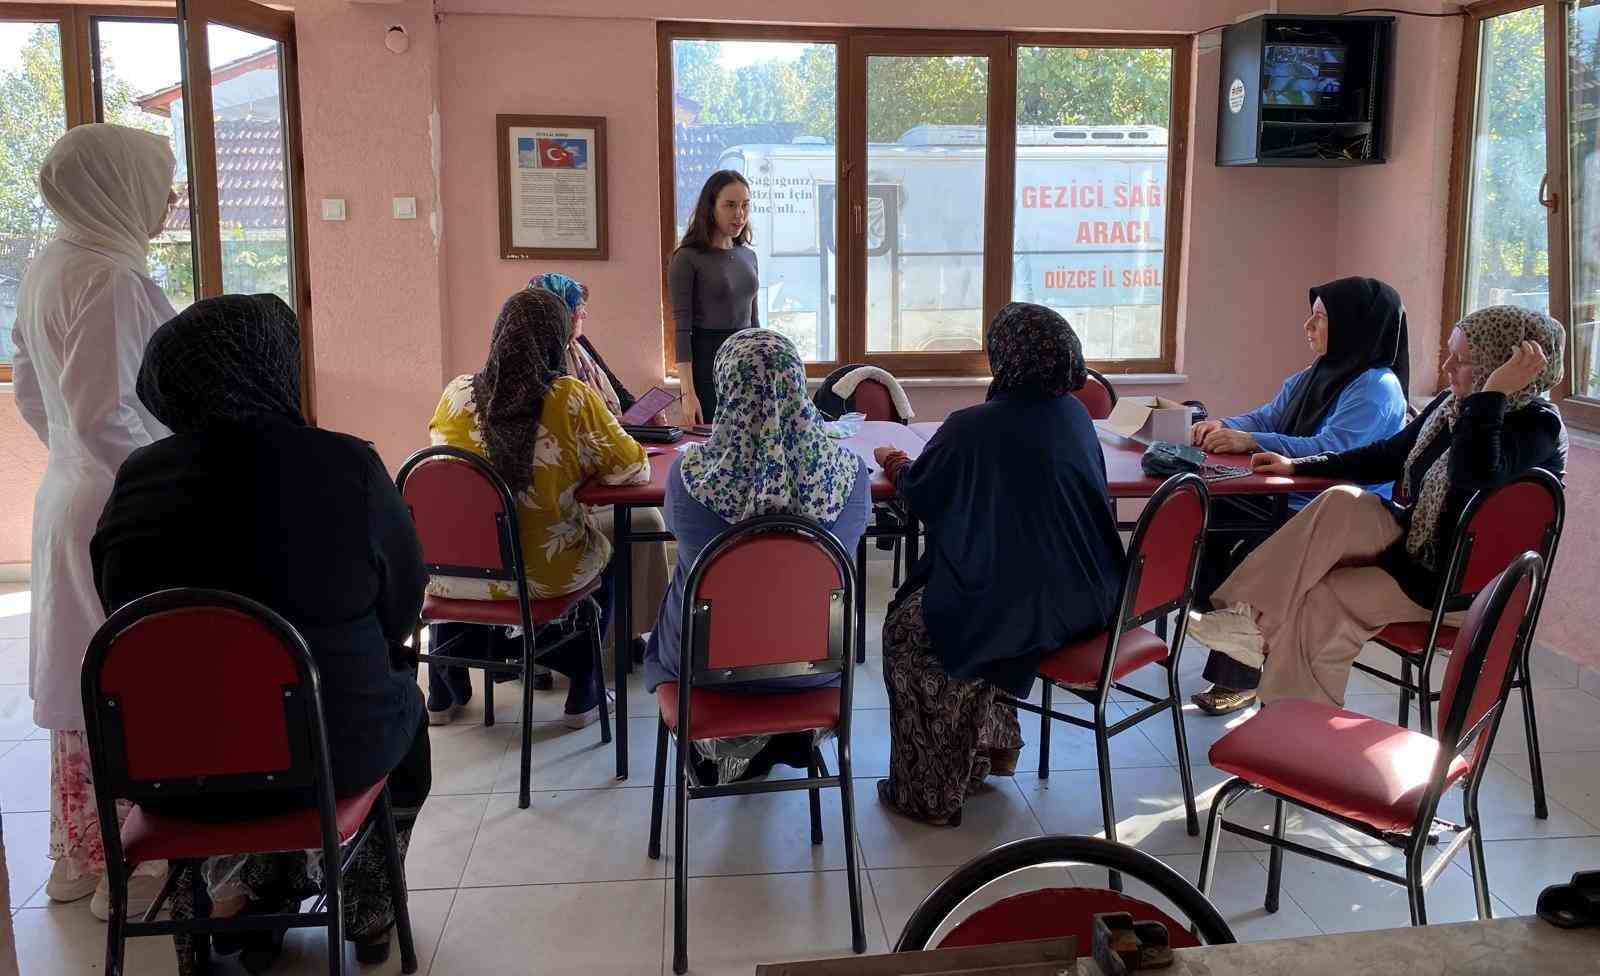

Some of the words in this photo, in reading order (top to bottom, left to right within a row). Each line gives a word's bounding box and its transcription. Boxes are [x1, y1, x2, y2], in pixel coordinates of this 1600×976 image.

[1022, 179, 1104, 208] GEZİCİ
[1113, 177, 1166, 208] SAĞ
[1076, 221, 1151, 244] ARACI
[1045, 265, 1097, 288] DÜZCE
[1103, 265, 1116, 288] İL
[1122, 264, 1162, 288] SAĞL
